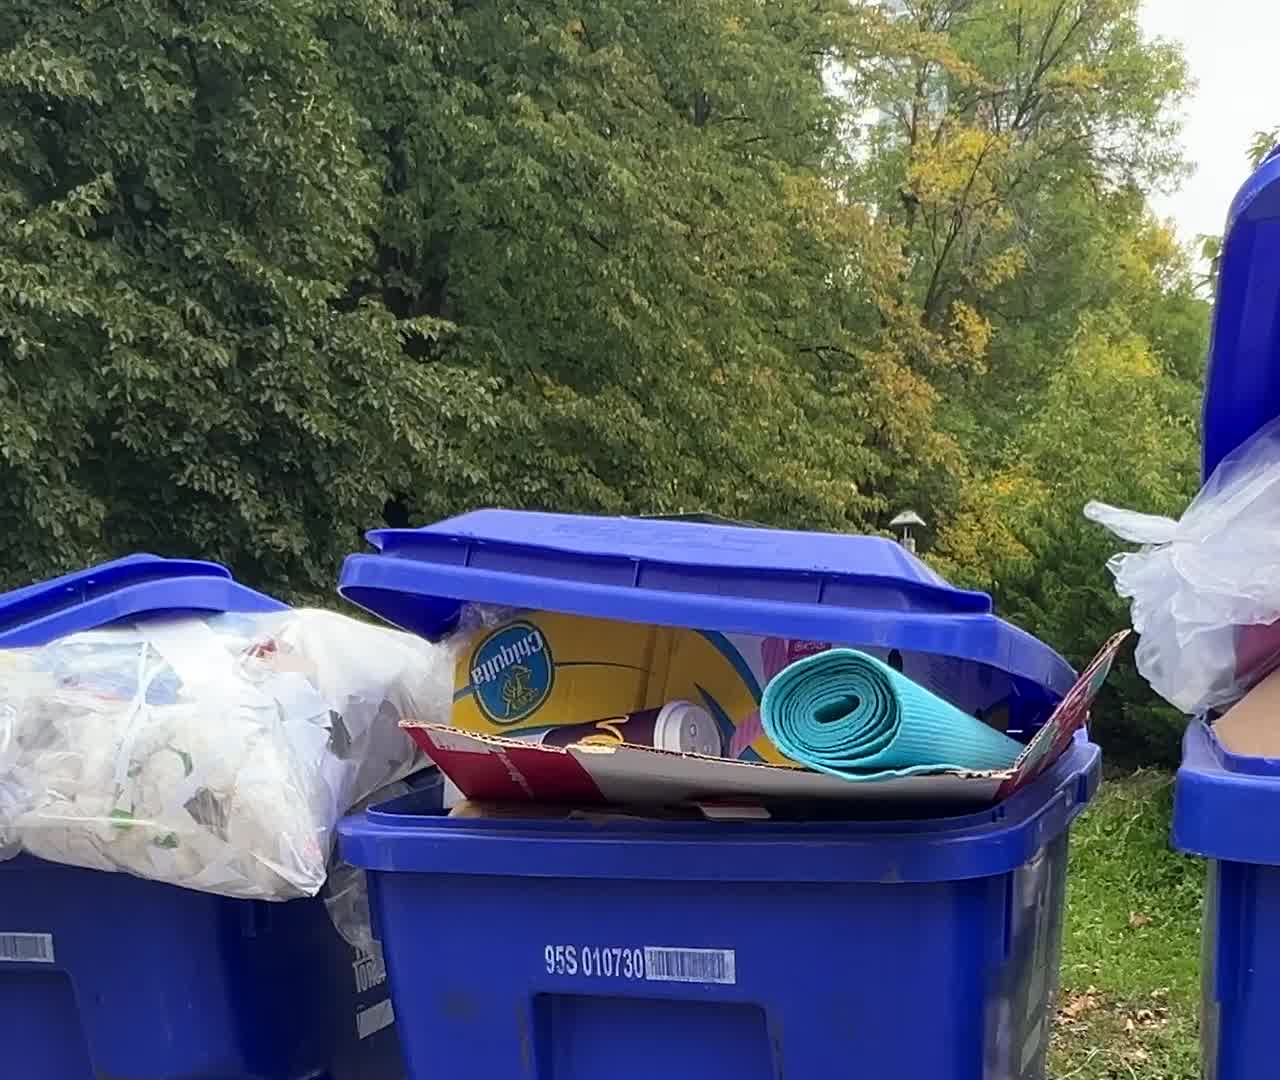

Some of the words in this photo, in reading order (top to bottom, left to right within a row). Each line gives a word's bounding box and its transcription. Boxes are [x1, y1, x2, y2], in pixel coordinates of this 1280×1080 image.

[471, 630, 544, 685] Chiquita
[544, 944, 578, 975] 95S
[581, 946, 644, 979] 010730
